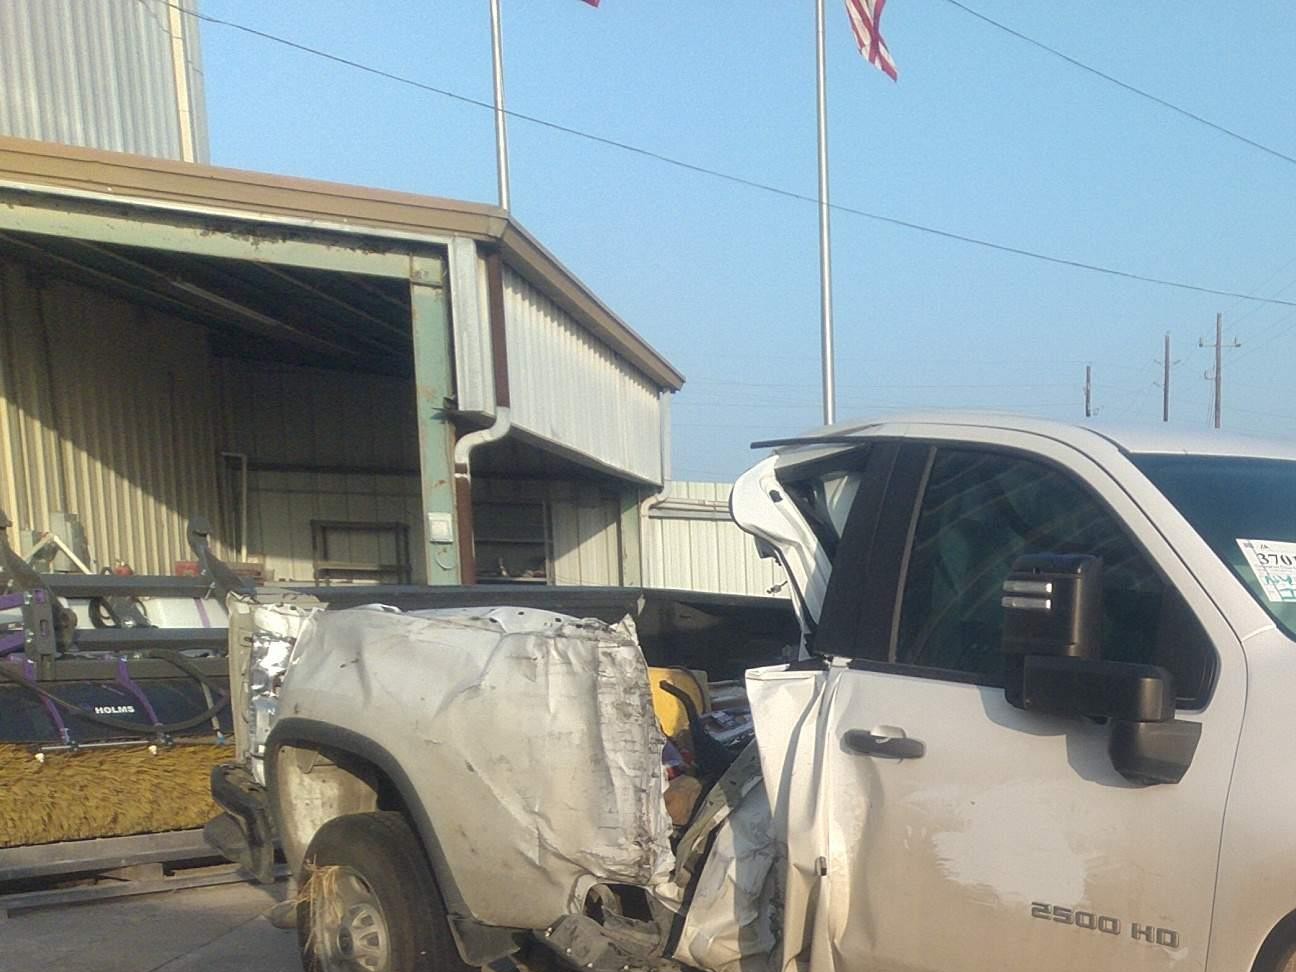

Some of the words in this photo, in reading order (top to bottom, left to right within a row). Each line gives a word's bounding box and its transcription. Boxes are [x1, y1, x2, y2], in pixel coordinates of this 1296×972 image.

[95, 705, 135, 714] HOLMS
[1031, 901, 1121, 936] 2500
[1131, 922, 1180, 948] HD
